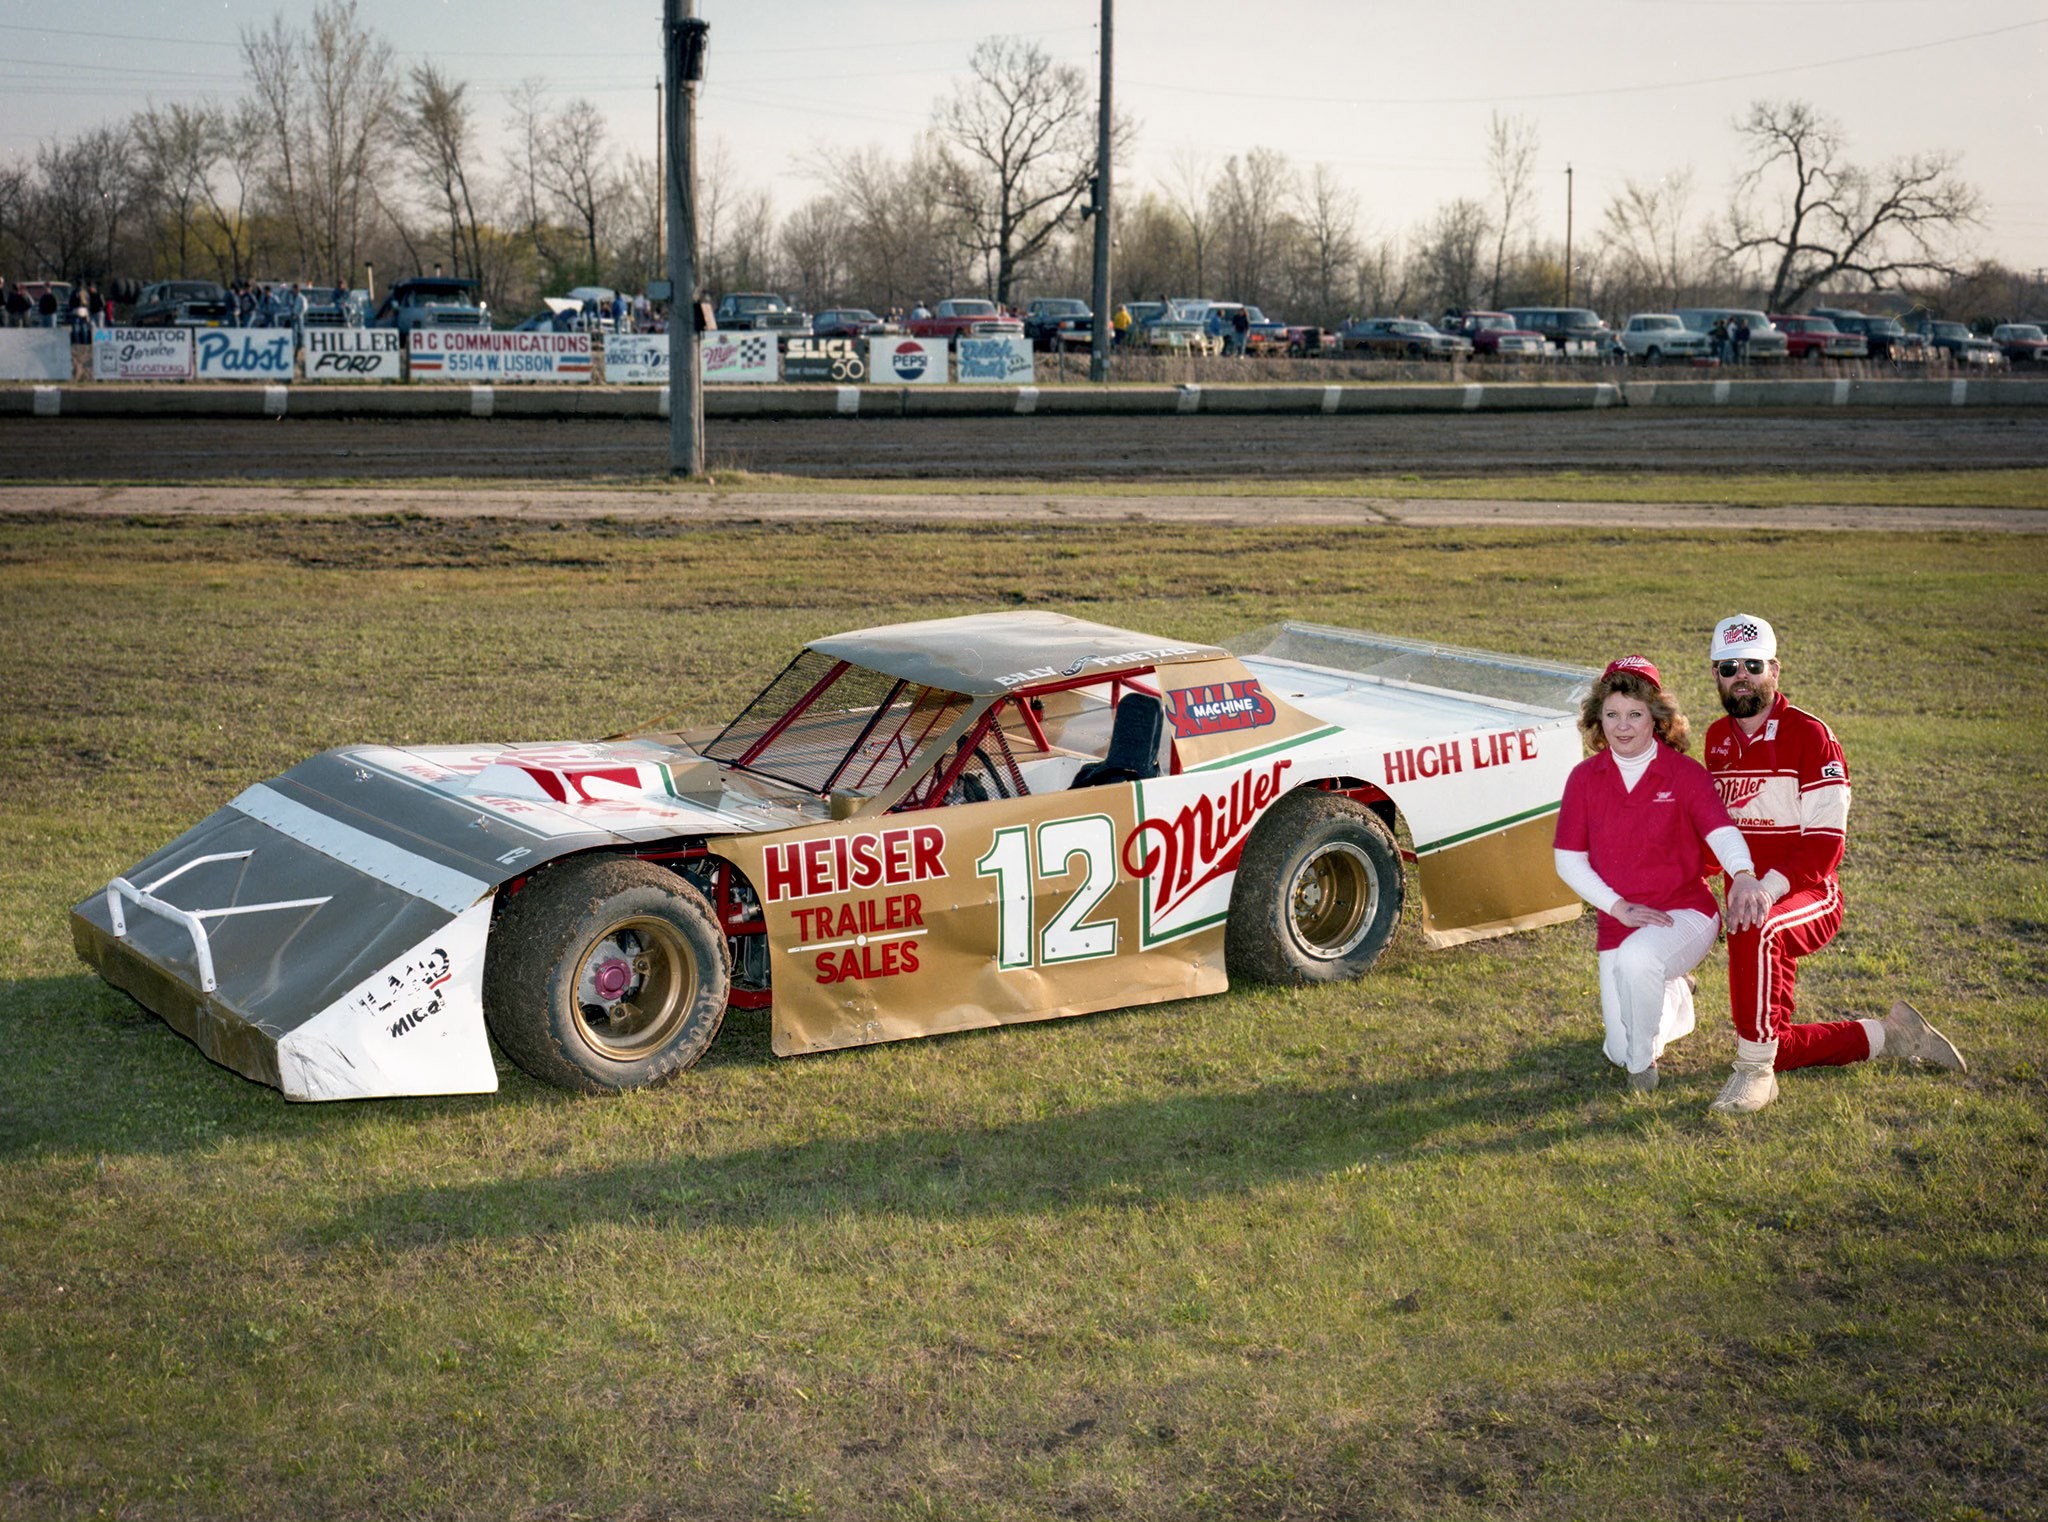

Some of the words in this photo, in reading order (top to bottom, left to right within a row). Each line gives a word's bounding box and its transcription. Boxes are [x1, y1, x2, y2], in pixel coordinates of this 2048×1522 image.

[115, 330, 185, 342] RADIATOR
[310, 332, 399, 351] HILLER
[428, 333, 437, 350] C
[444, 333, 589, 352] COMMUNICATIONS
[198, 332, 289, 371] Pabst
[893, 355, 928, 367] PEPSI
[315, 354, 382, 372] FORD
[449, 354, 484, 371] 5514
[504, 355, 553, 372] LISBON
[831, 359, 864, 380] 50
[1093, 650, 1198, 668] PRIETZEL
[993, 665, 1058, 687] BILLY
[1193, 698, 1254, 718] MACHINE
[1382, 740, 1463, 785] HIGH
[1471, 728, 1539, 770] LIFE
[1714, 776, 1768, 806] Miller
[1740, 817, 1776, 826] RACING
[1122, 758, 1293, 915] Miller
[496, 846, 532, 865] 12
[762, 824, 949, 904] HEISER
[975, 812, 1119, 972] 12
[791, 893, 925, 942] TRAILER
[815, 940, 920, 984] SALES
